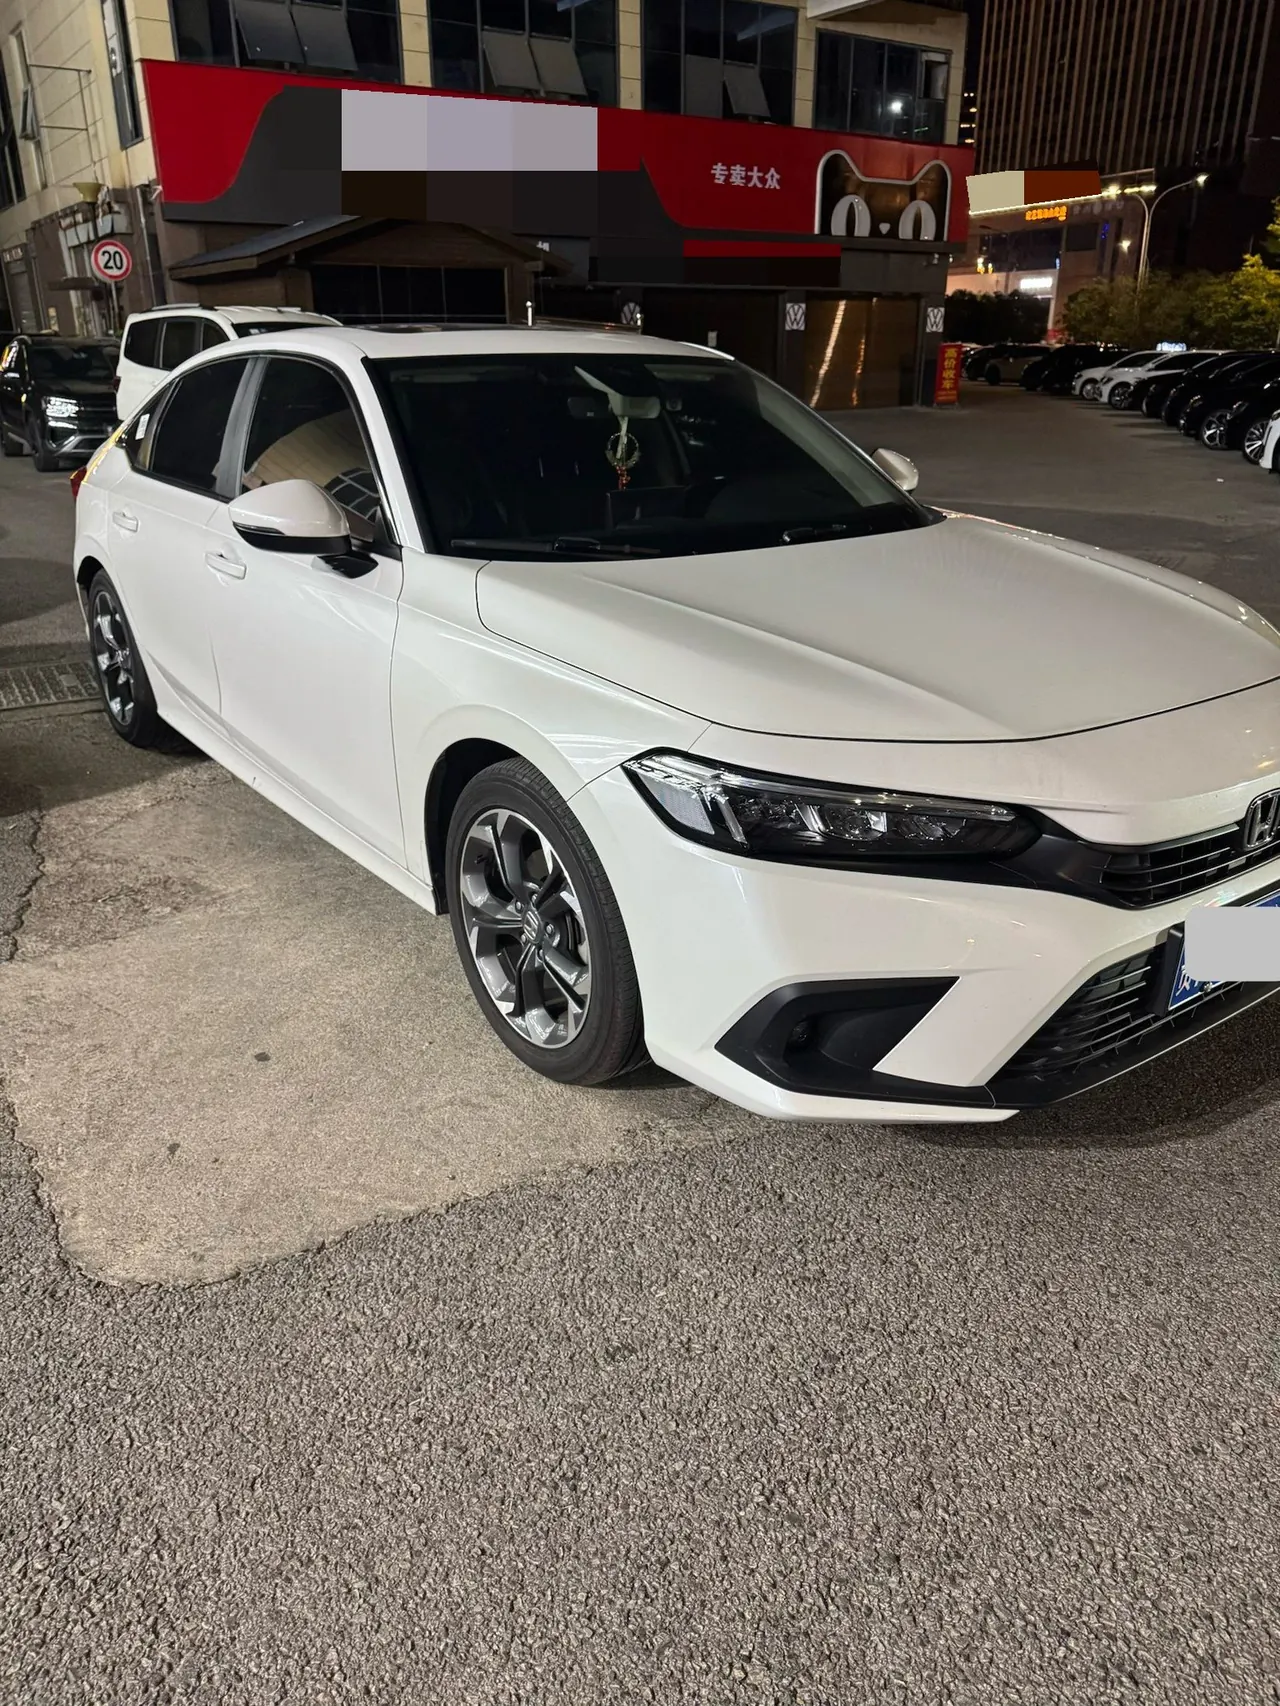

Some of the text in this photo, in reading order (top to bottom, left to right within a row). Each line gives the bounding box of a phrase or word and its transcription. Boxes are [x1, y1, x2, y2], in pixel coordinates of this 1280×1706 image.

[710, 162, 781, 190] 专卖大众
[101, 250, 124, 270] 20
